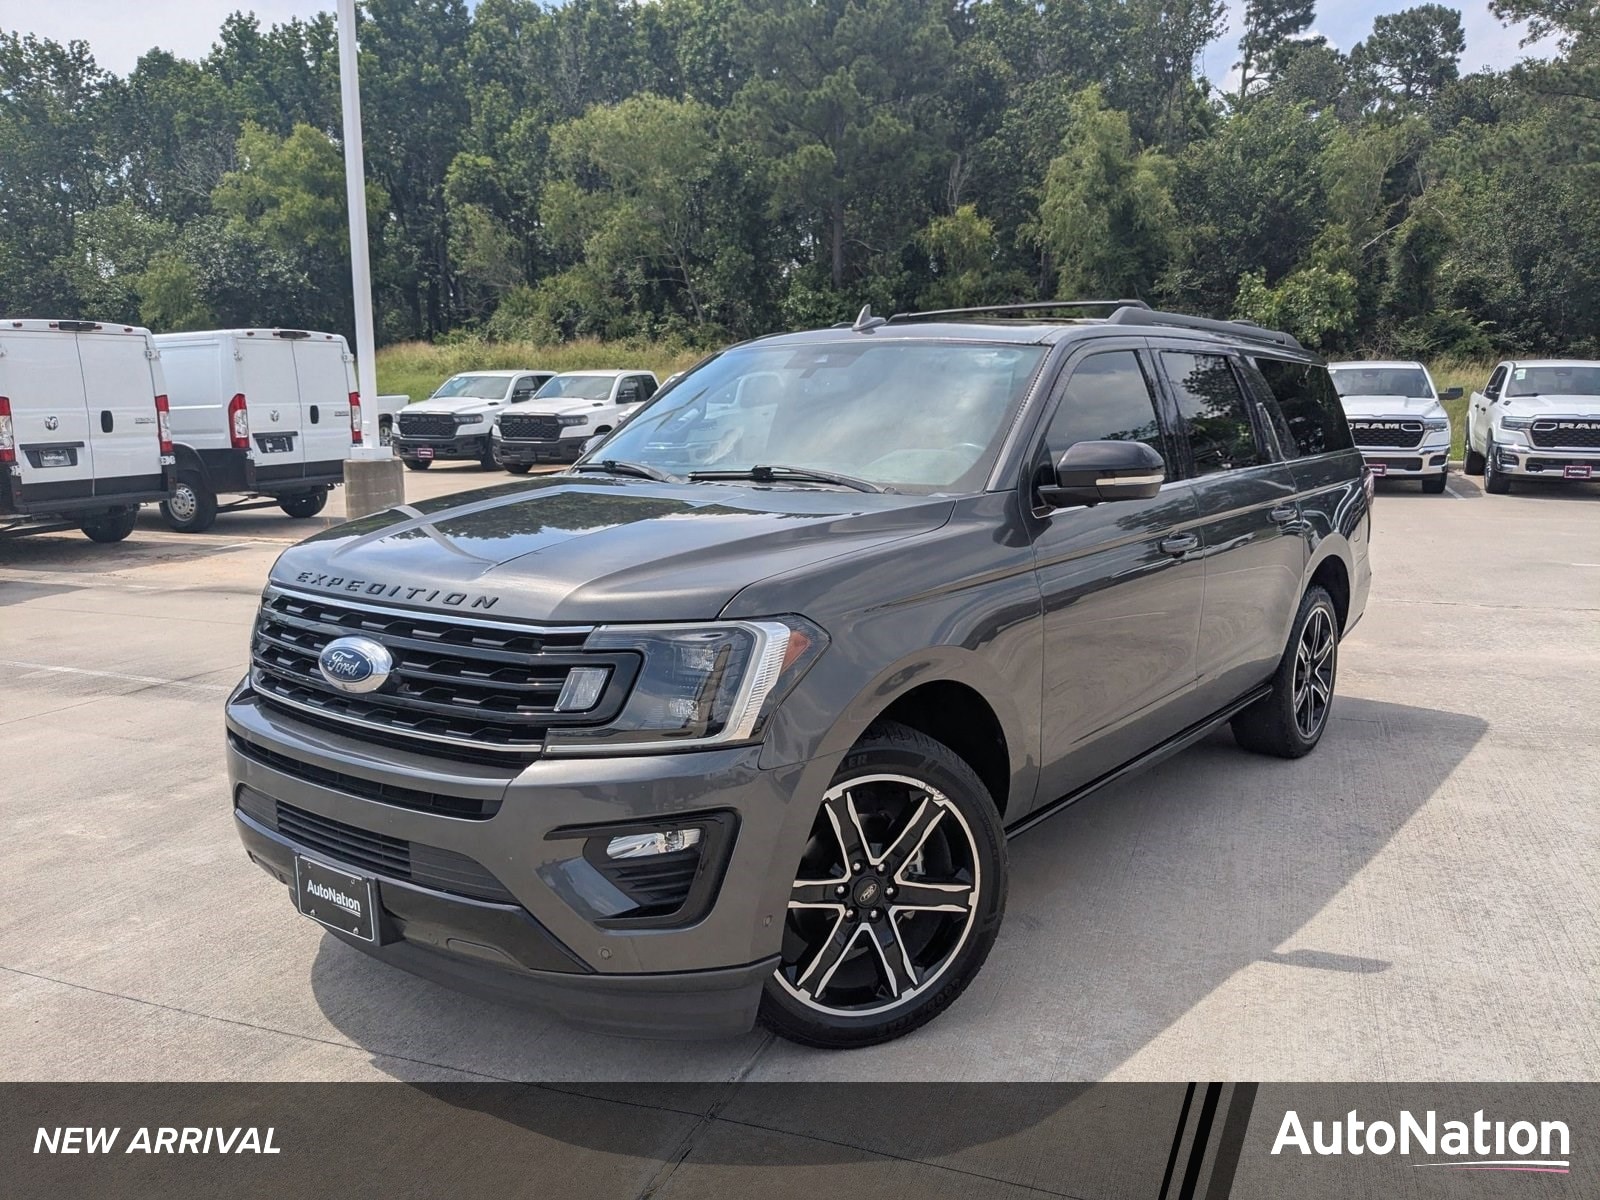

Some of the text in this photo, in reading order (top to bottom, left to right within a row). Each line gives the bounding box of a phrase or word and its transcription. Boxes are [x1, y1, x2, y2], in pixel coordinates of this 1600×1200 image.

[1354, 422, 1400, 430] RAM
[295, 571, 501, 611] EXPEDITION
[327, 650, 362, 678] Ford
[307, 879, 361, 912] AutoNation
